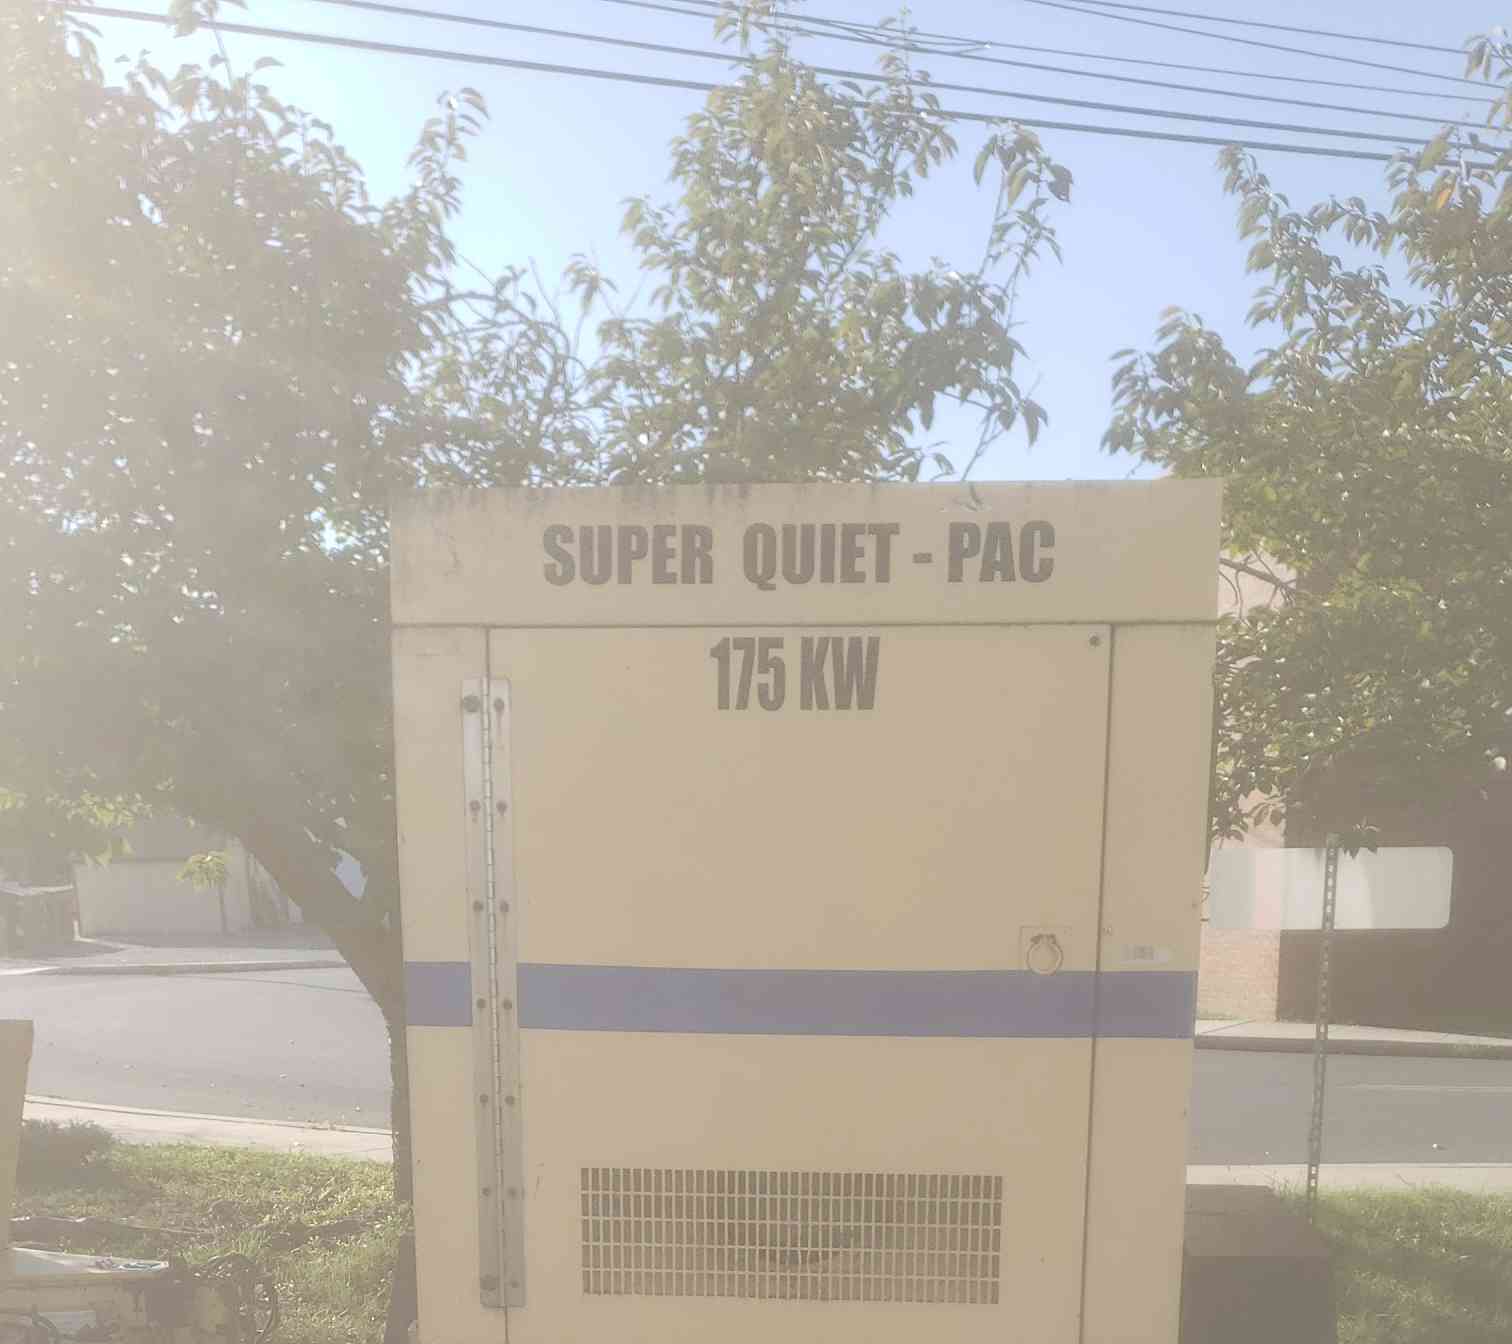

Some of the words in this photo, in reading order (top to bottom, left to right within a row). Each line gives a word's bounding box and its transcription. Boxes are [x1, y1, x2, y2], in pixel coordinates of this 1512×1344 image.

[543, 523, 714, 586] SUPER
[709, 637, 787, 712] 175
[799, 636, 881, 711] KW
